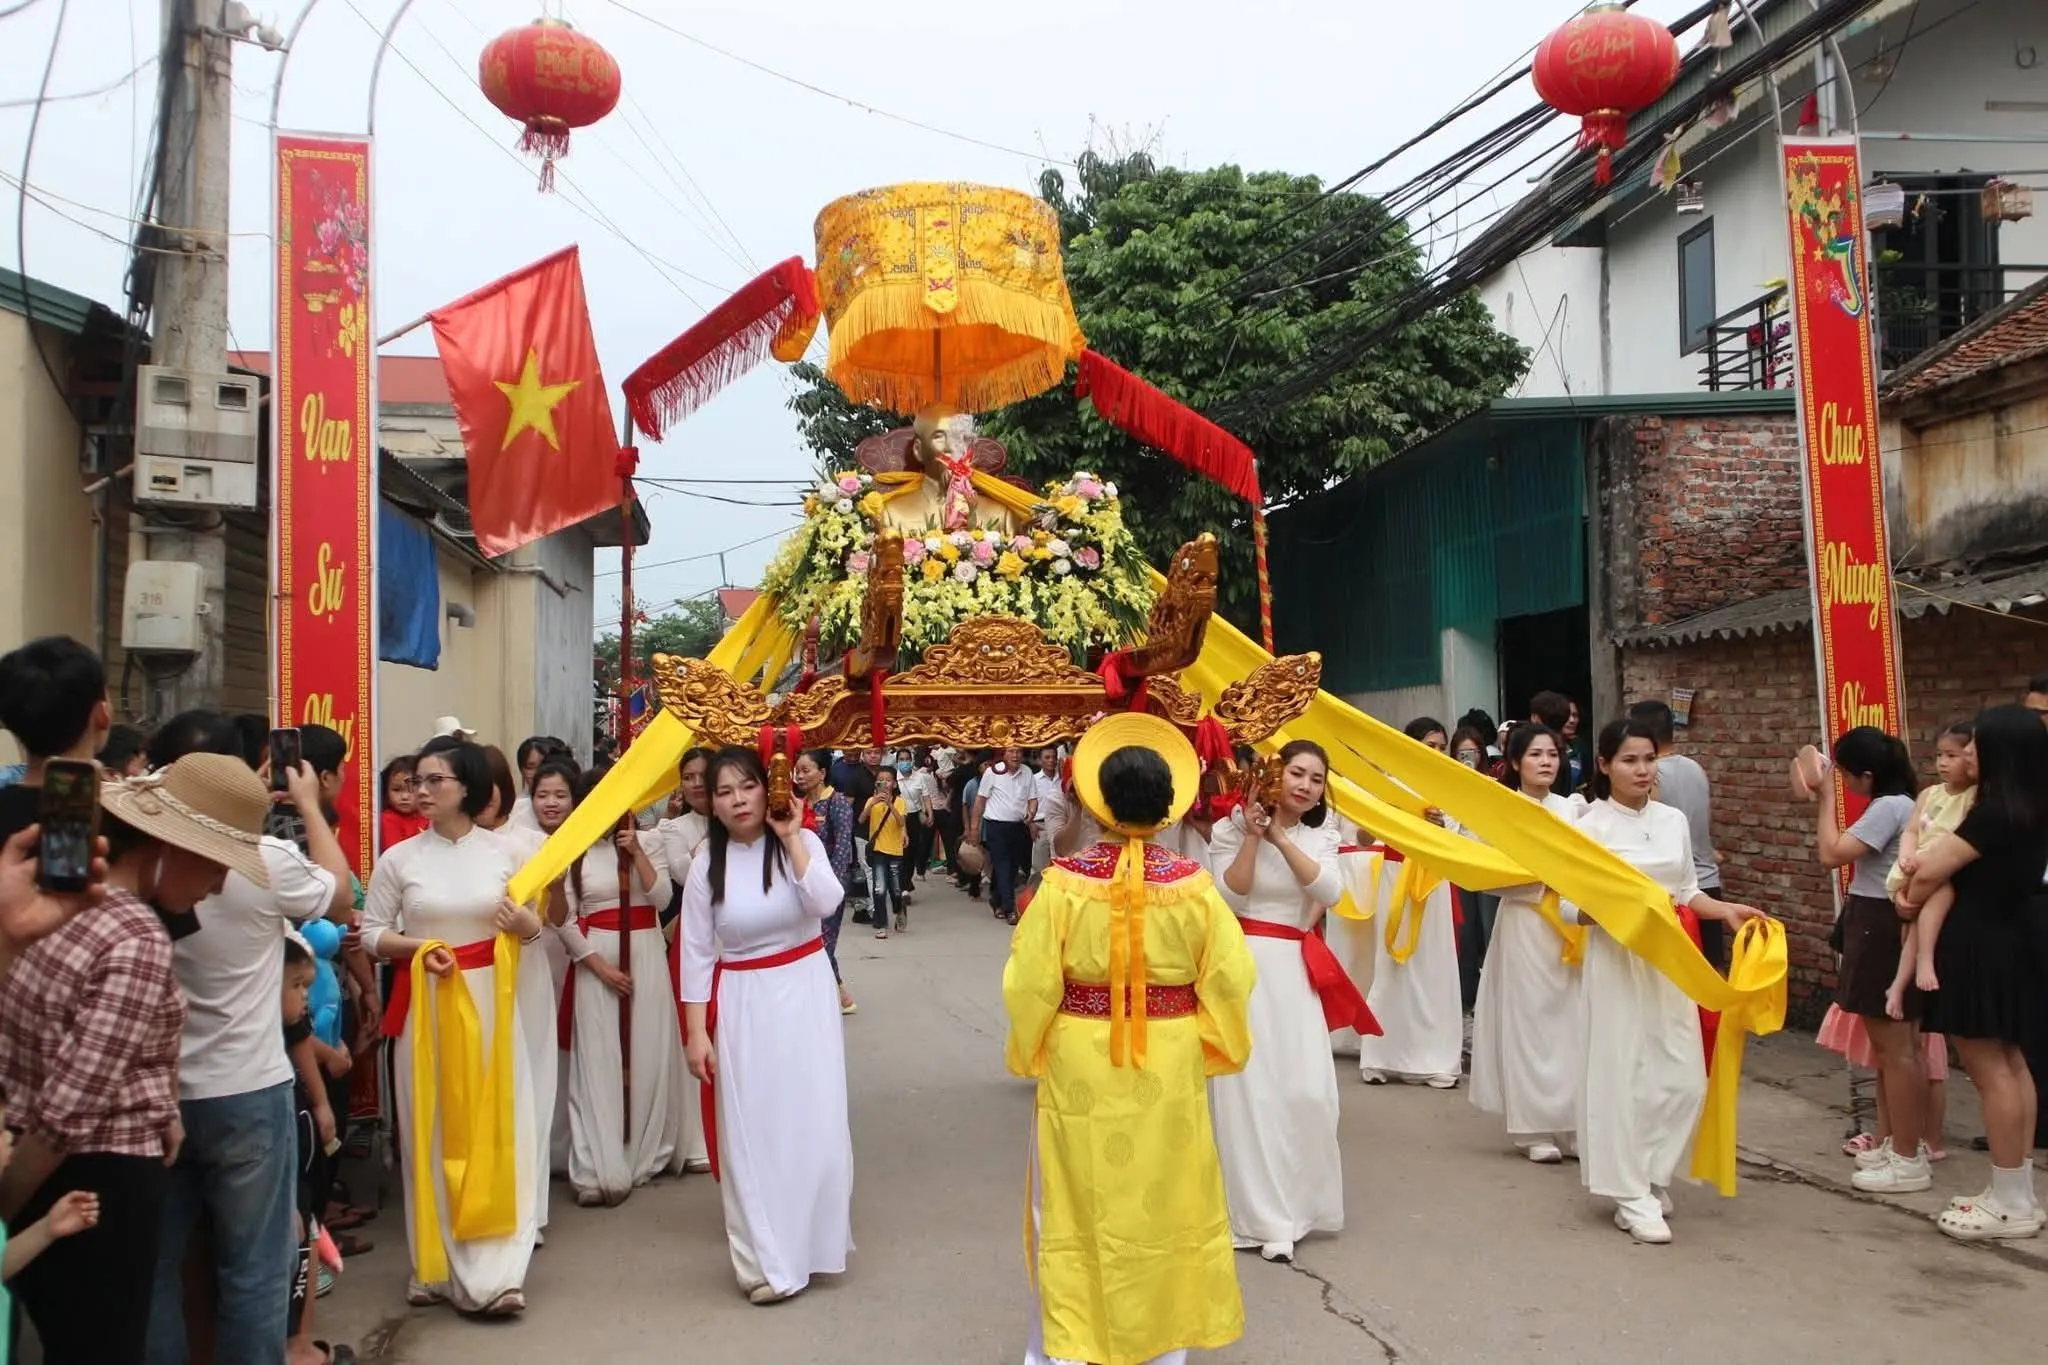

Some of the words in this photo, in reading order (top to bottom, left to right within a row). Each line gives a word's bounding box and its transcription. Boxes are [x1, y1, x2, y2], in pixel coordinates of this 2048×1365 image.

[301, 391, 352, 474] Vạn
[1821, 401, 1865, 465] Chúc
[309, 542, 345, 624] Sự
[1824, 541, 1883, 630] Mừng
[1841, 680, 1888, 734] Năm
